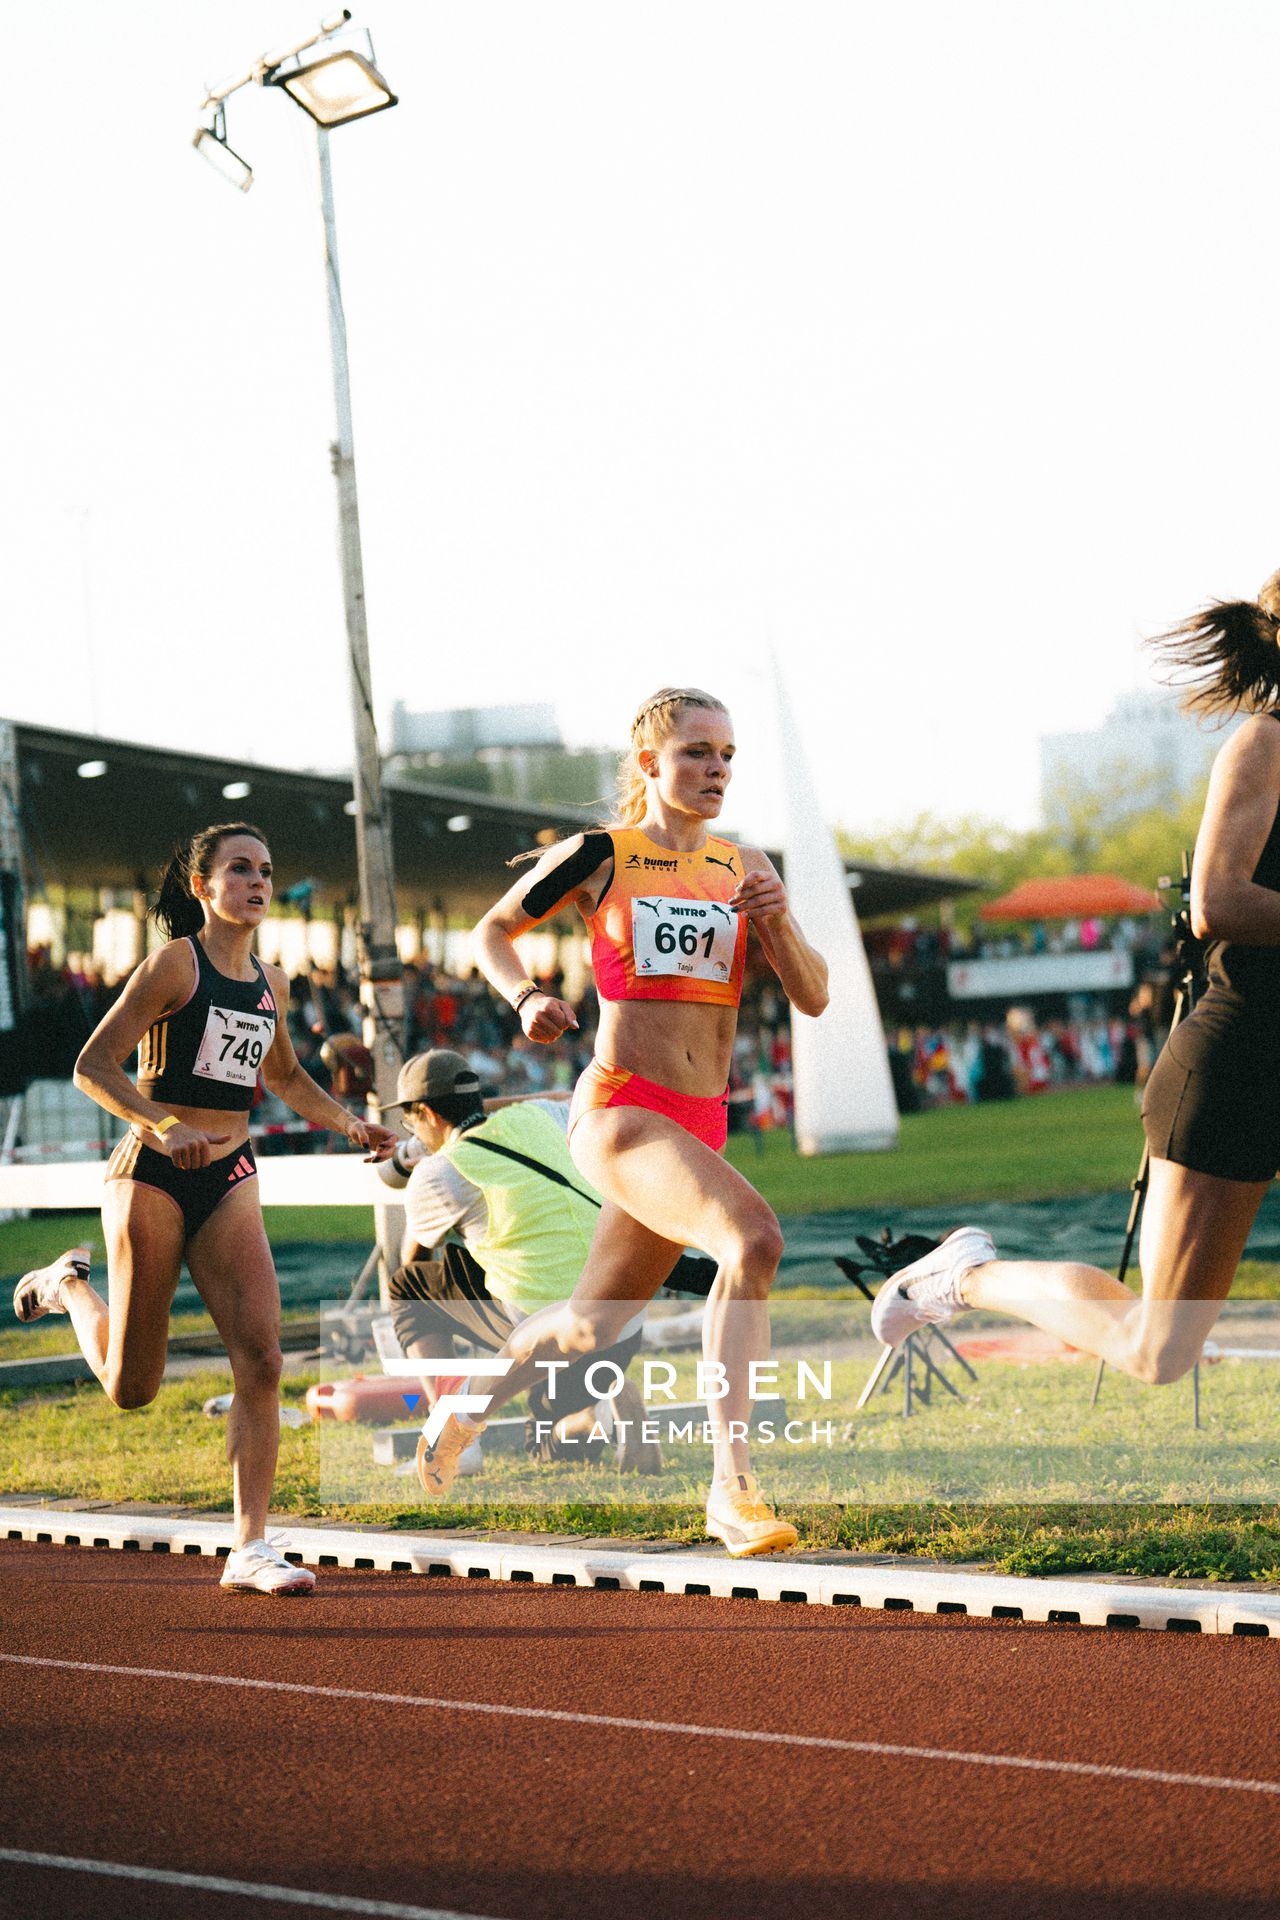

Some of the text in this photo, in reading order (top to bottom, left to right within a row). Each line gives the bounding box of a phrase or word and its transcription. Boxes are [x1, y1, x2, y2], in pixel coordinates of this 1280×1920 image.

[644, 857, 678, 867] bunert
[668, 907, 707, 918] NITRO
[655, 922, 715, 958] 661
[677, 962, 694, 972] Tanja
[235, 1020, 259, 1033] NITRO
[219, 1034, 263, 1069] 749
[226, 1071, 246, 1081] Bianka
